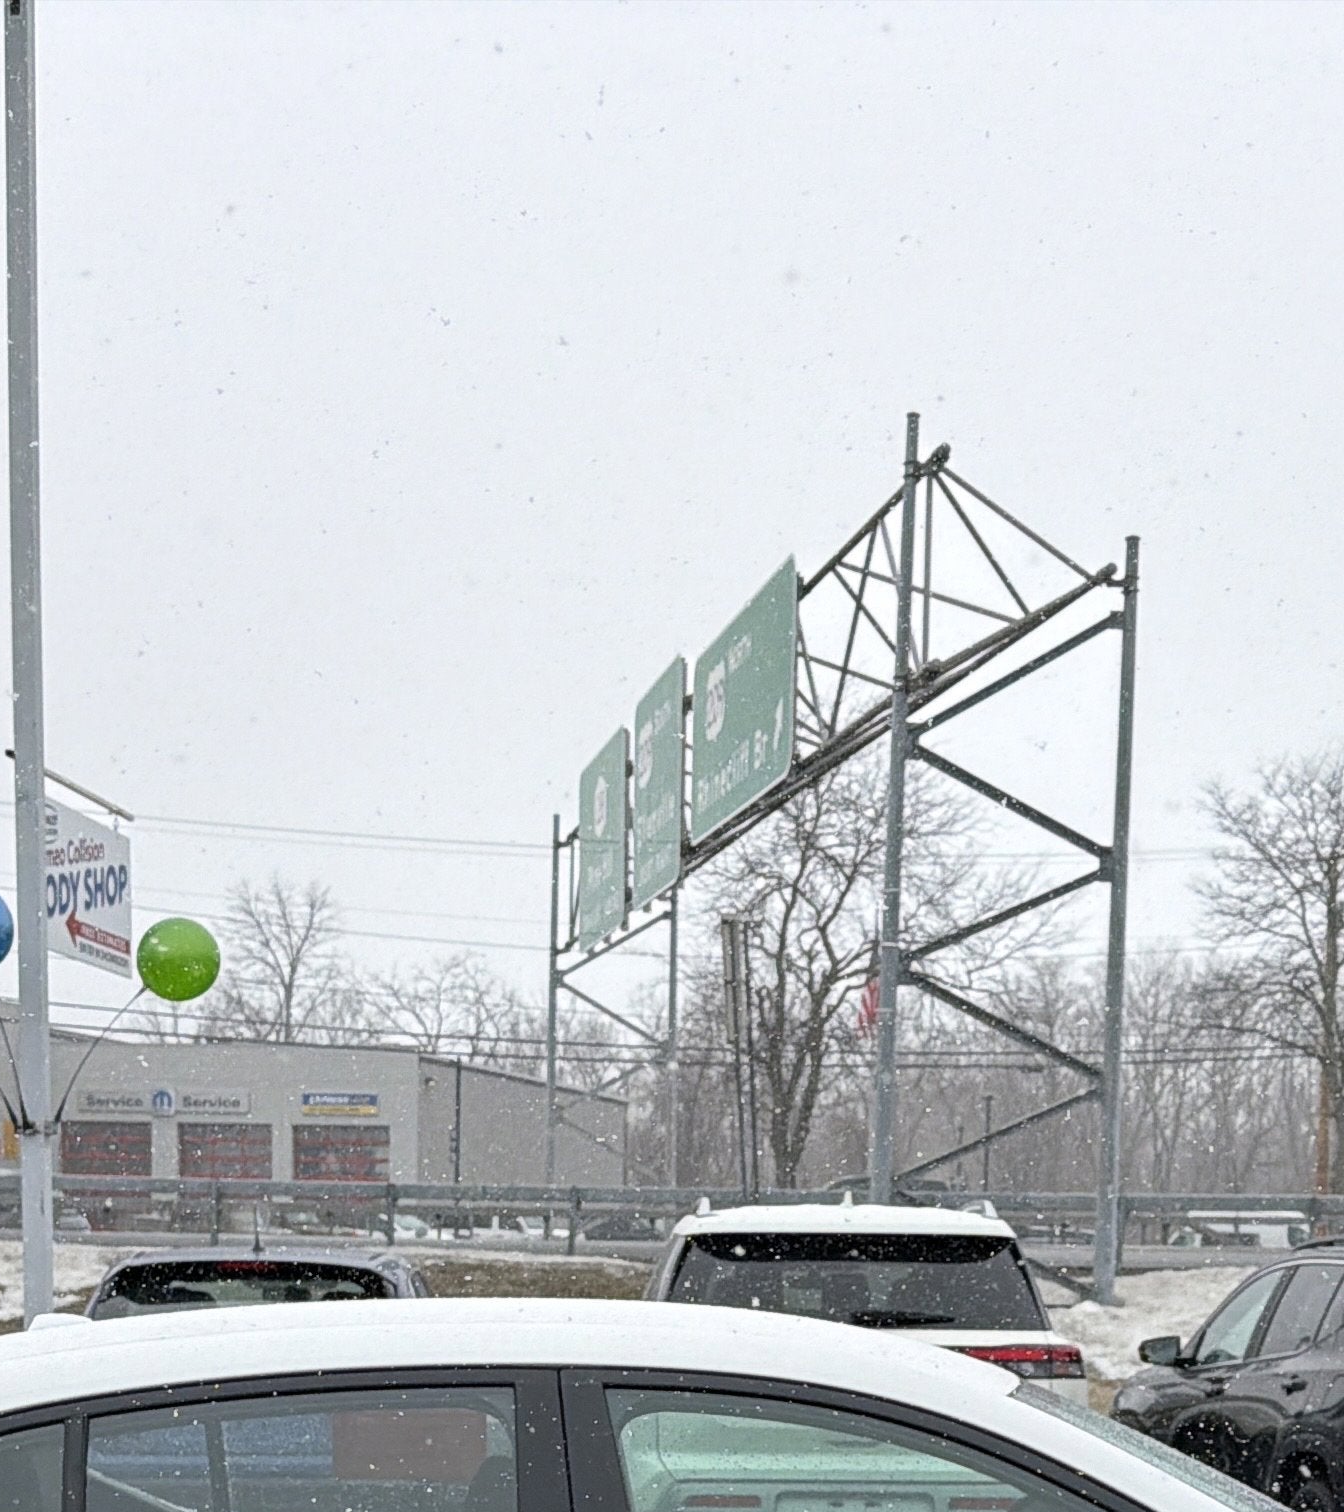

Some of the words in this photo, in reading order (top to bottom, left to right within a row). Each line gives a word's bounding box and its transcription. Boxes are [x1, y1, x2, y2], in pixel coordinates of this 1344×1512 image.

[47, 870, 81, 918] ODY
[84, 865, 127, 911] SHOP
[86, 1095, 144, 1109] Service
[182, 1095, 241, 1109] Service
